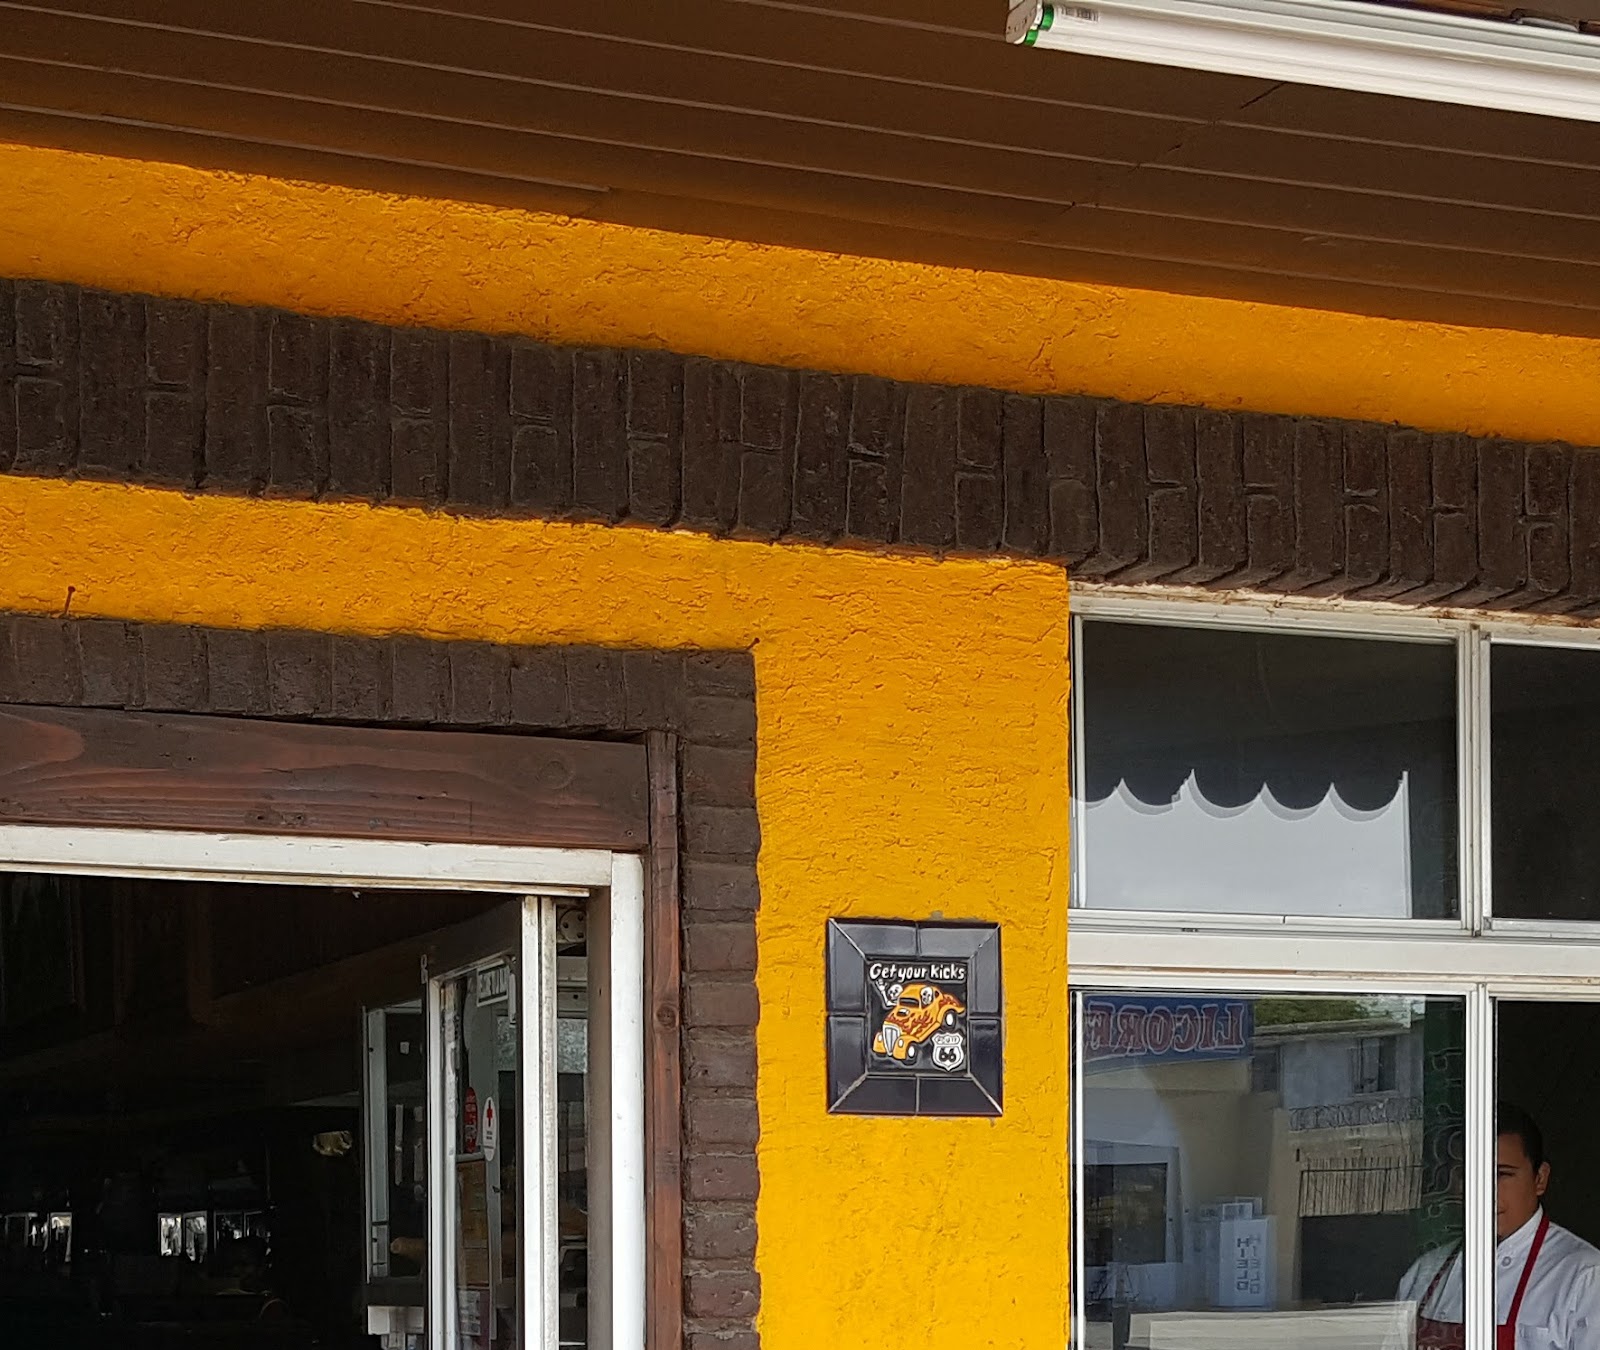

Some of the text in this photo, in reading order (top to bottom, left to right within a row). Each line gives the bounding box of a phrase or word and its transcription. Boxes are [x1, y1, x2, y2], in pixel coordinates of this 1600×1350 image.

[869, 963, 897, 979] Get
[898, 966, 928, 982] your
[938, 1046, 957, 1063] 66
